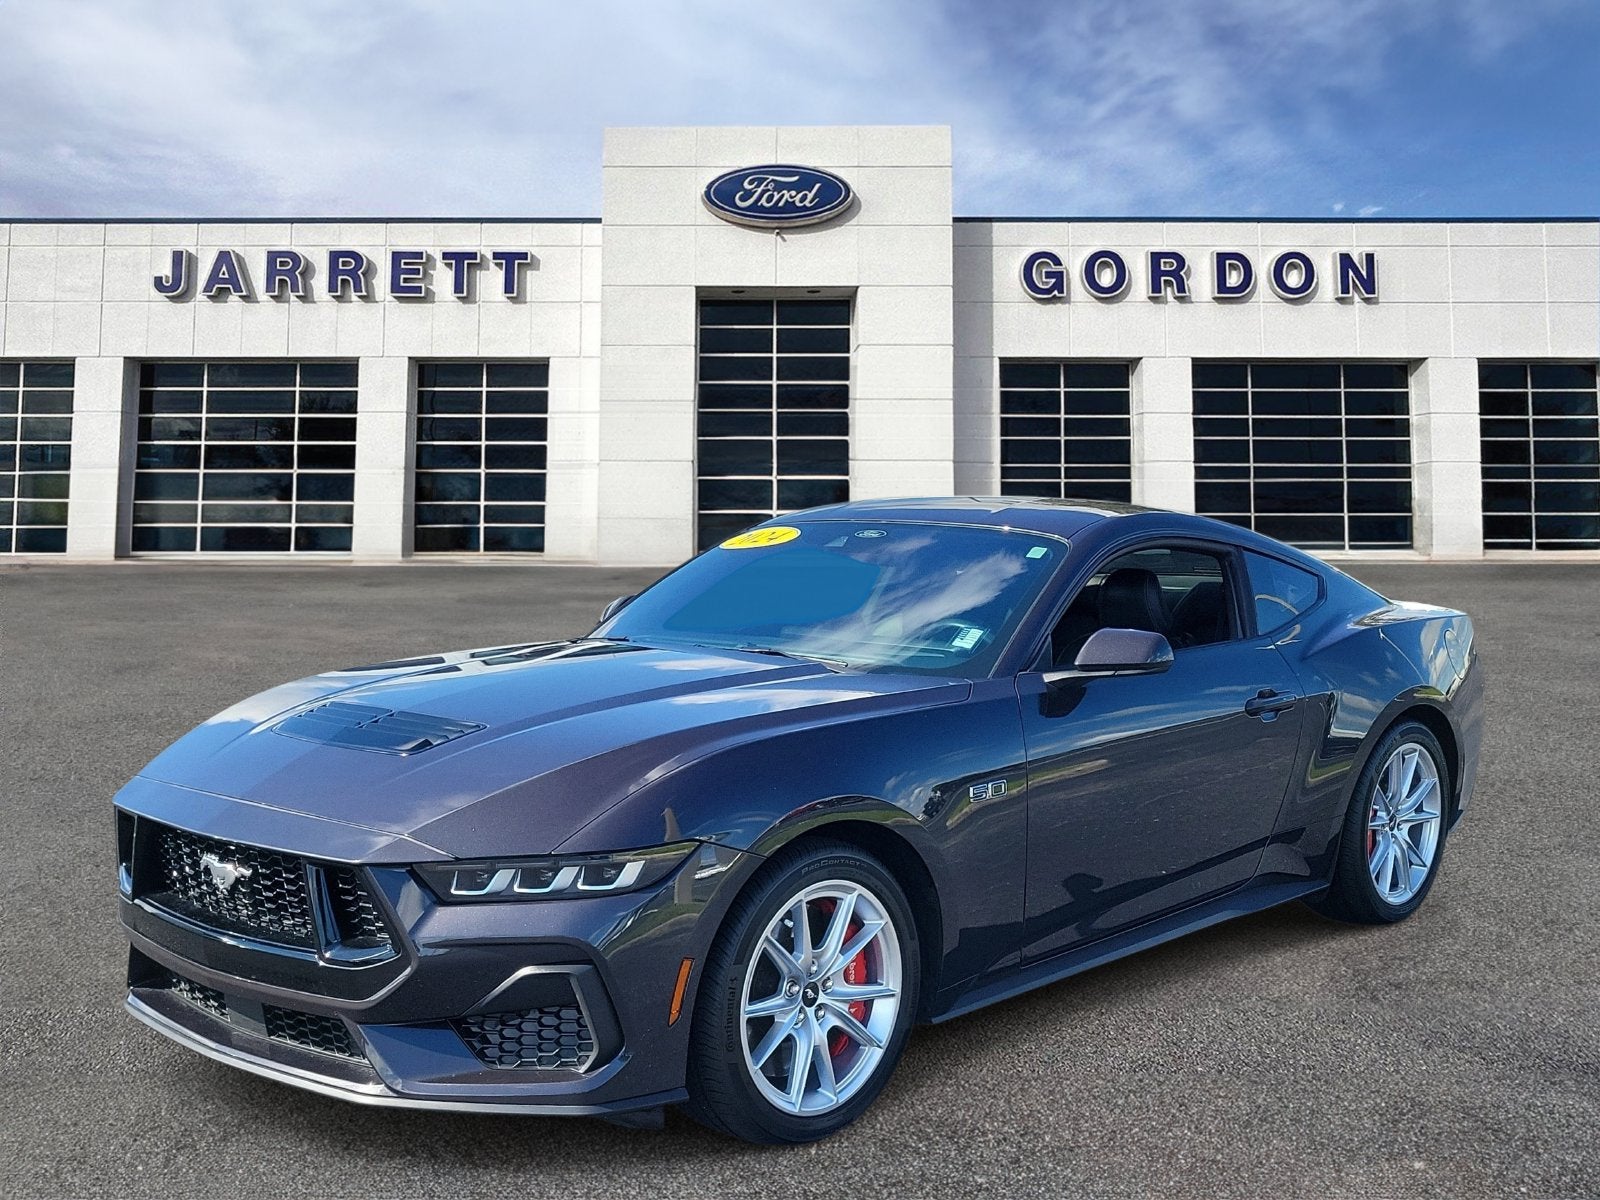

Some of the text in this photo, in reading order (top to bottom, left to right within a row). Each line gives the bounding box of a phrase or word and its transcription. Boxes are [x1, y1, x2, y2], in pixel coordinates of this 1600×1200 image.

[734, 174, 822, 208] Ford
[153, 249, 532, 298] JARRETT
[1020, 250, 1378, 299] GORDON
